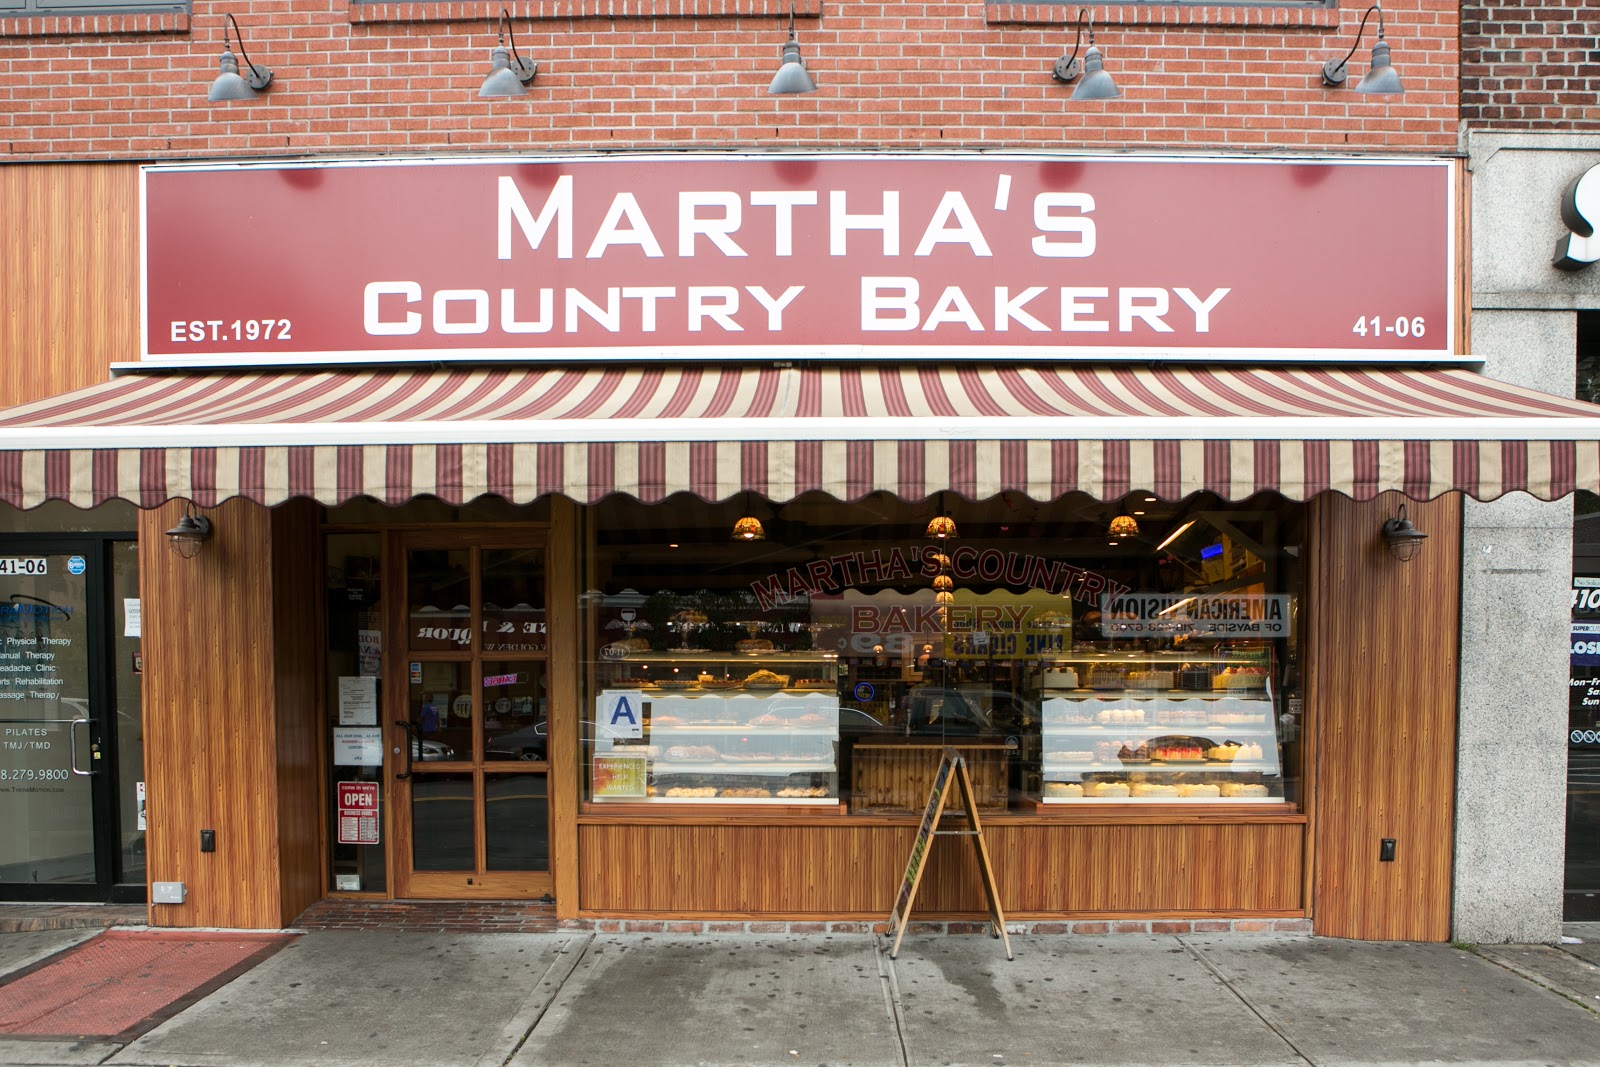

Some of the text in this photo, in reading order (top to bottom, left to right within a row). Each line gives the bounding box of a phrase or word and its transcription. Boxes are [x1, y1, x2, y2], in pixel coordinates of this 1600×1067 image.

[498, 174, 1097, 260] MARTHA'S
[363, 276, 1232, 335] COUNTRY BAKERY
[170, 319, 292, 342] EST.1972
[1352, 315, 1426, 338] 41-06
[0, 559, 46, 574] 41-06
[750, 545, 1130, 613] MARTHA'S COUNTRY
[851, 604, 1033, 635] BAKERY
[6, 637, 37, 647] Physical
[41, 637, 72, 647] Therapy
[25, 651, 56, 661] Therapy
[35, 664, 56, 672] Clinic
[15, 677, 64, 686] Rehabilitation
[1582, 697, 1600, 706] Sun
[610, 696, 637, 725] A
[5, 728, 48, 736] PILATES
[3, 741, 51, 750] TMJ/TMD
[344, 792, 373, 807] OPEN
